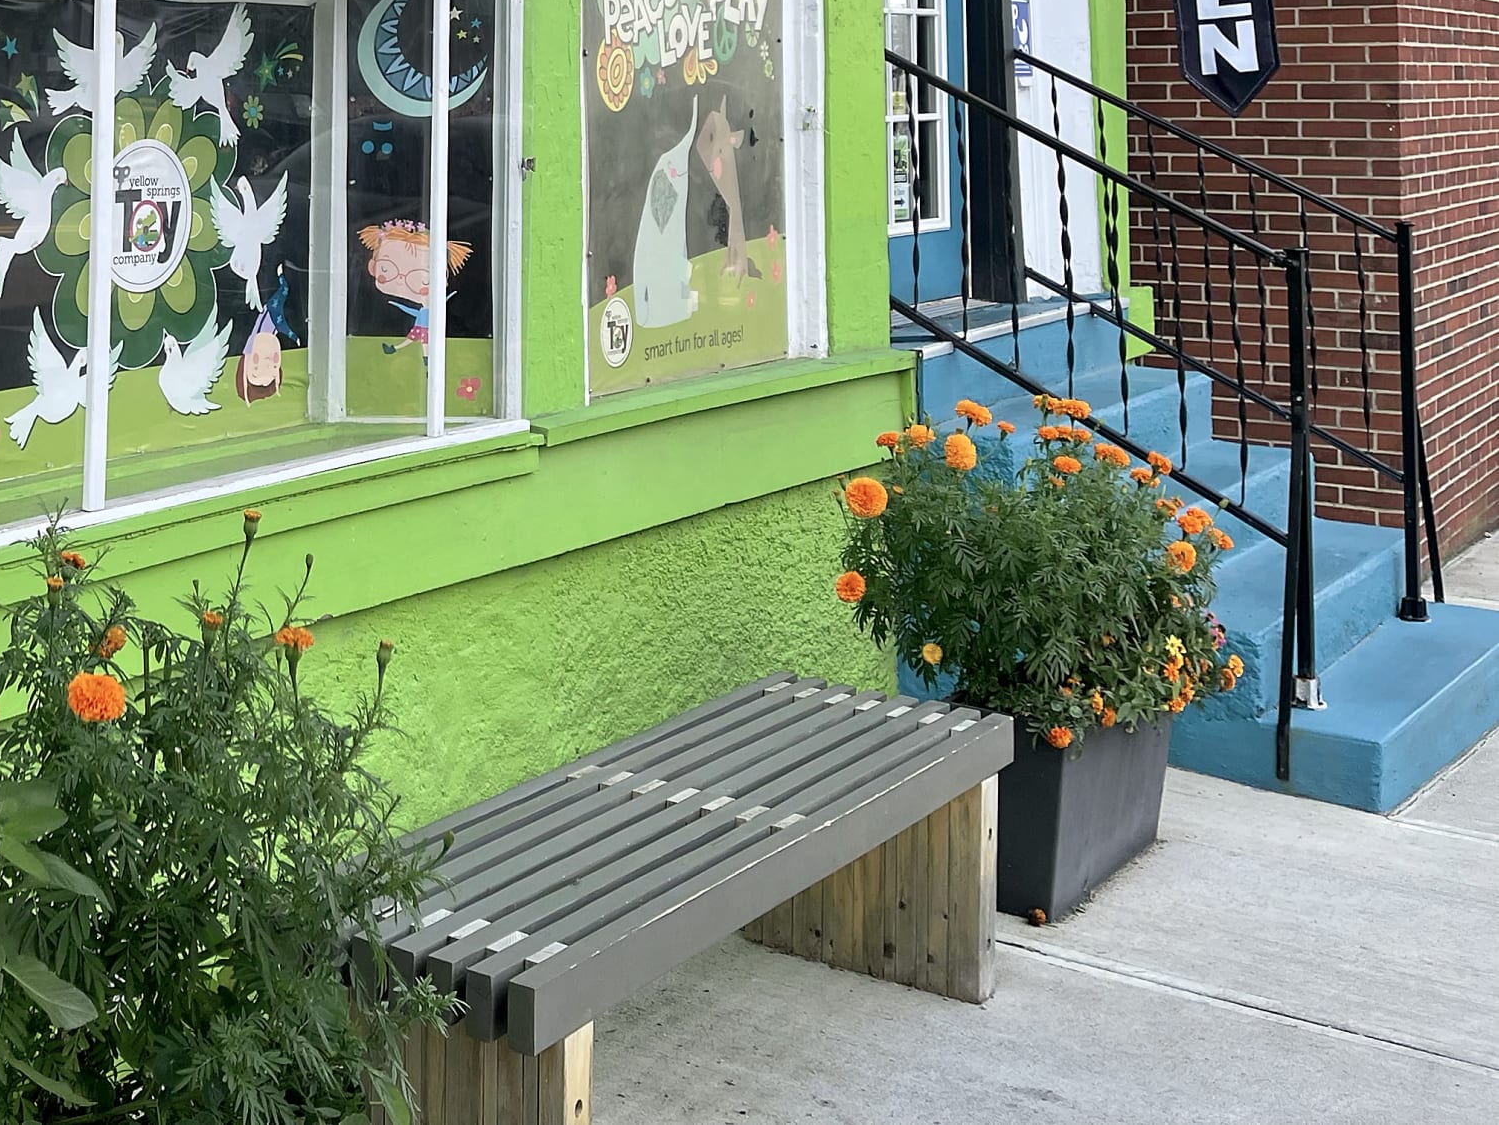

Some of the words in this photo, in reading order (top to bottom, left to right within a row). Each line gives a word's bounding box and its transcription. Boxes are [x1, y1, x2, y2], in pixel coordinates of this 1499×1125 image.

[657, 3, 713, 68] LOVE
[129, 176, 159, 190] yellow
[146, 185, 181, 199] springs
[113, 253, 157, 266] company
[644, 341, 673, 361] smart
[674, 336, 691, 353] fun
[693, 332, 706, 350] for
[708, 330, 719, 346] all
[721, 325, 744, 349] ages!
